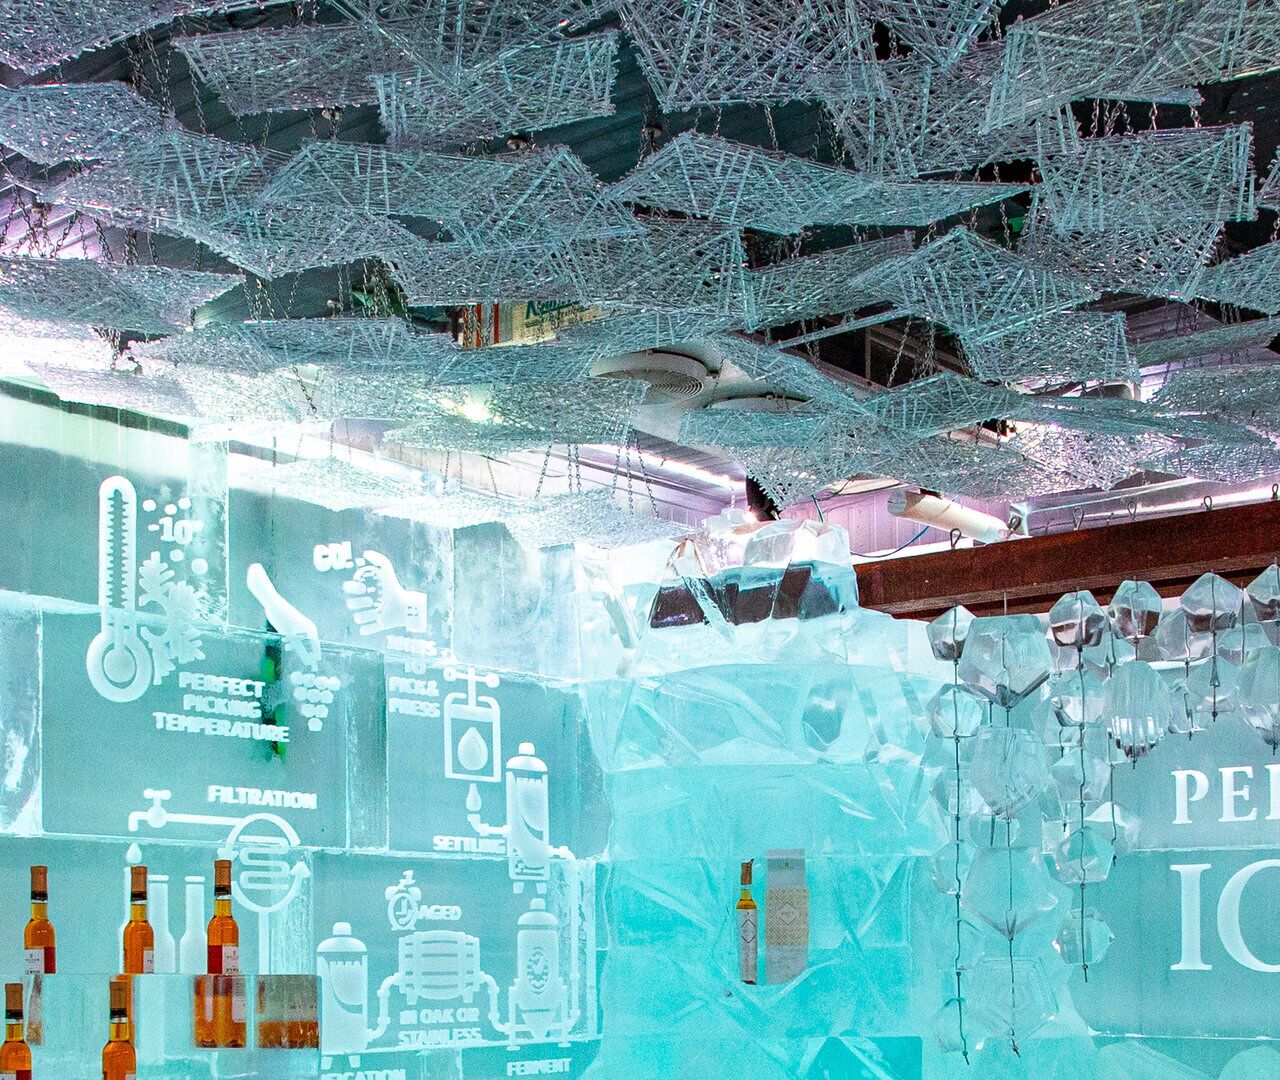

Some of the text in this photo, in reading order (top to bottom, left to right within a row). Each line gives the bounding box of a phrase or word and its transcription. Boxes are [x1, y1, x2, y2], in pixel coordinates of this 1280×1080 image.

[178, 671, 266, 698] PERFECT
[182, 693, 262, 719] PICKING
[388, 697, 441, 718] PRESS
[152, 711, 290, 743] TEMPERATURE
[207, 785, 318, 810] FILTRATION
[432, 835, 506, 854] SETTLING
[417, 904, 462, 921] AGED
[420, 1008, 455, 1025] OAK
[456, 1007, 480, 1023] OR
[398, 1027, 483, 1047] STAINLESS
[506, 1058, 573, 1077] FERMENT
